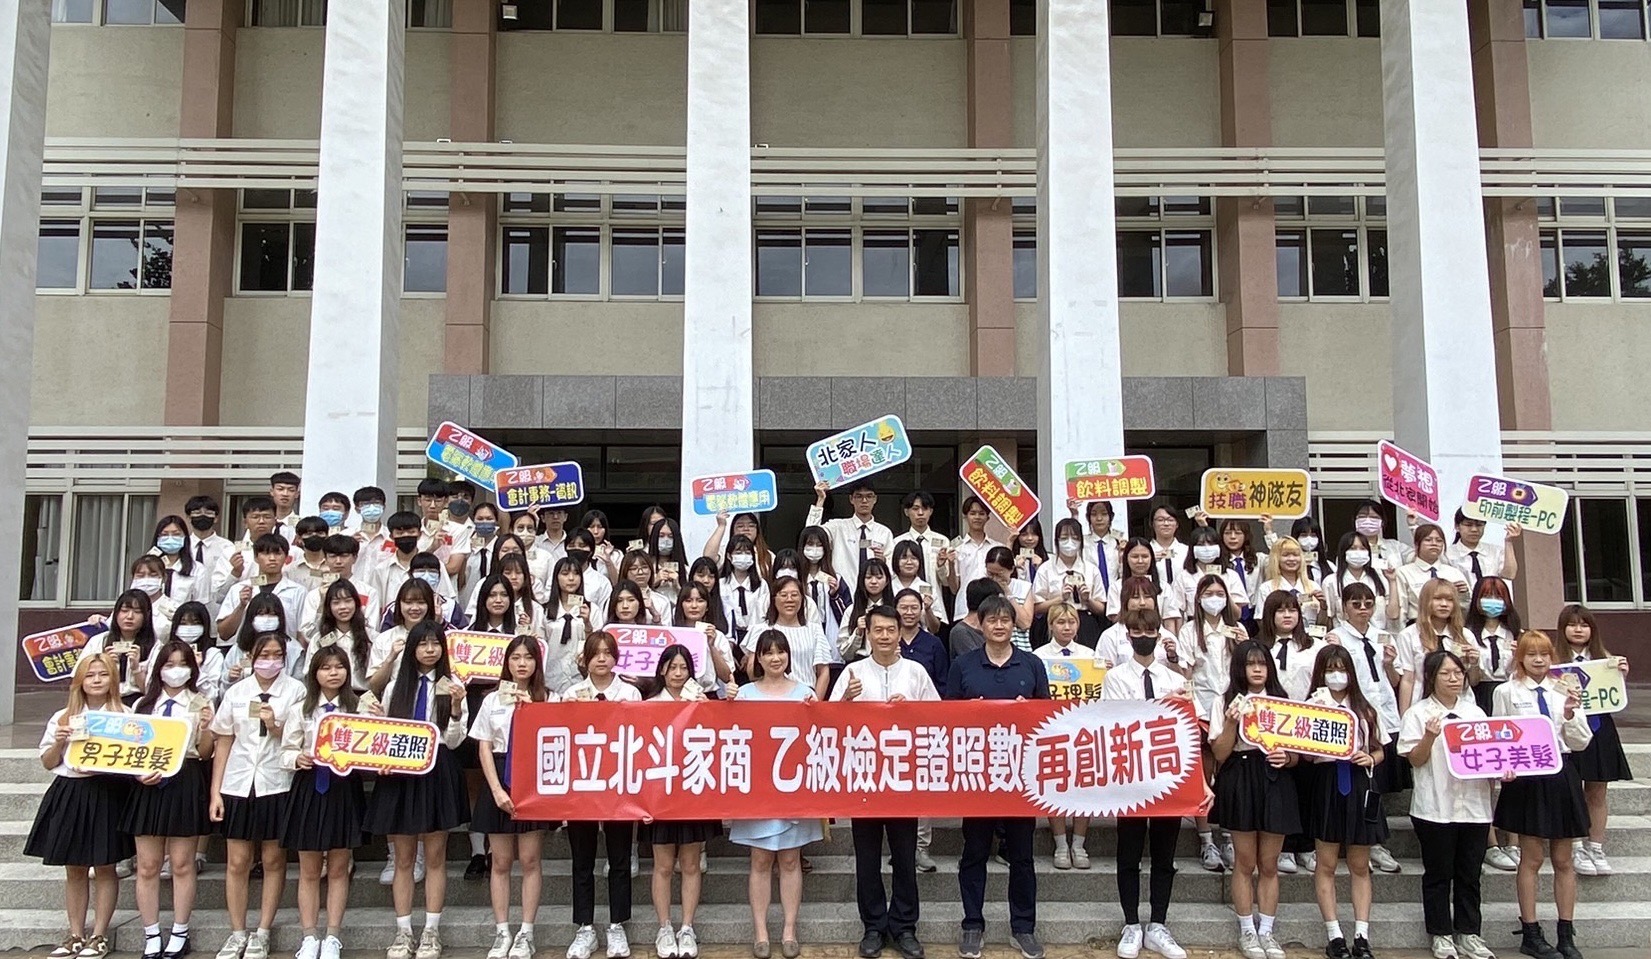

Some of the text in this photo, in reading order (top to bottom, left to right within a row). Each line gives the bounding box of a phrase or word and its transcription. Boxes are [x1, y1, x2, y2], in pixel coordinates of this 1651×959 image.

[817, 431, 877, 467] 北家人
[840, 444, 900, 476] 職場達人
[505, 469, 532, 485] 乙級
[985, 454, 1009, 480] 乙級
[1074, 461, 1101, 476] 乙級
[1401, 459, 1435, 495] 夢想
[967, 467, 1025, 526] 飲料調製
[1075, 477, 1149, 499] 飲料調製
[1382, 474, 1439, 515] 從北家開始
[1477, 478, 1508, 496] 乙級
[1478, 498, 1558, 530] 印前製程-PC
[33, 633, 63, 652] 乙級
[617, 628, 648, 645] 乙級
[454, 643, 504, 667] 雙乙級
[1258, 709, 1348, 746] 雙乙級證照
[1456, 722, 1493, 741] 乙級
[79, 741, 174, 772] 男子理髮
[331, 727, 429, 760] 雙乙級證照
[536, 714, 1183, 797] 國立北斗家商 乙級檢定證照數 再創新高
[1460, 743, 1556, 772] 女子美髮
